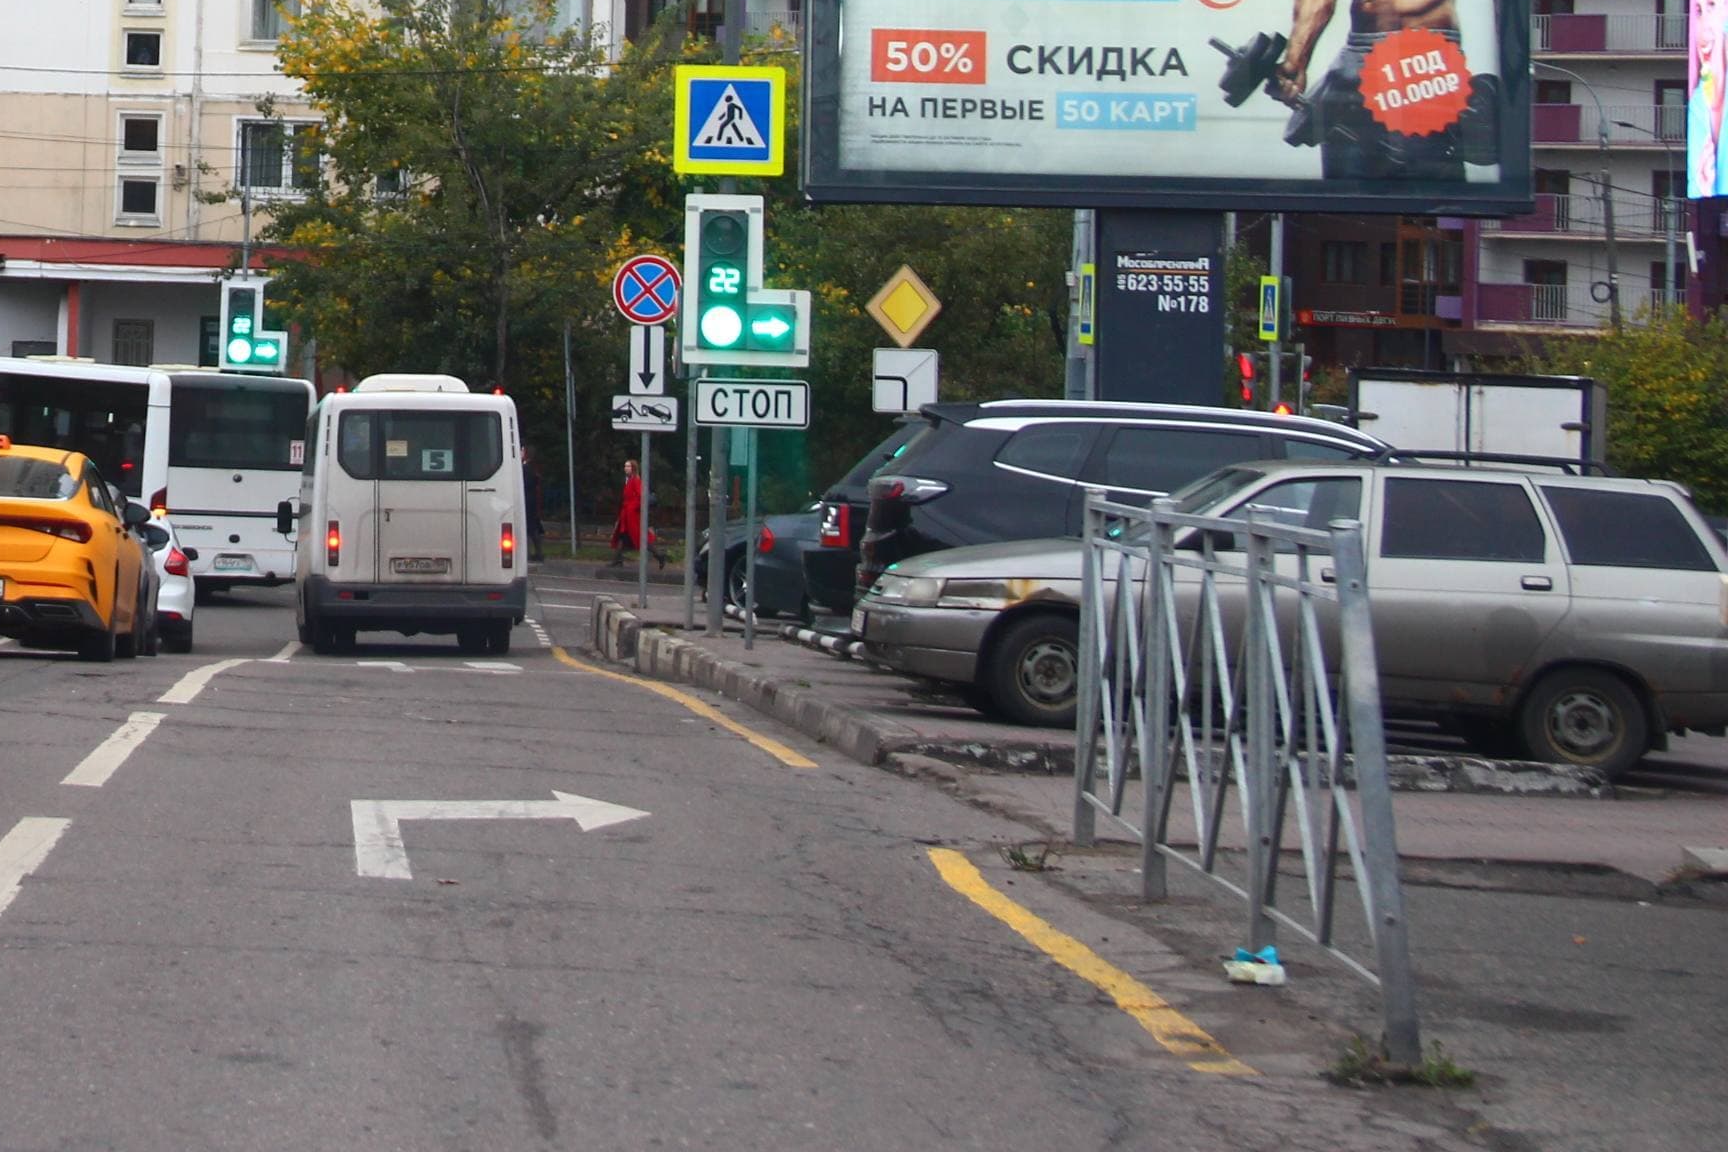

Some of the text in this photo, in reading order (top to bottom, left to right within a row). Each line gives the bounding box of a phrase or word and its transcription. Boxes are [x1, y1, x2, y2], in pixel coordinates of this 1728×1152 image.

[885, 41, 973, 73] 50%
[1007, 45, 1189, 81] СКИДКА
[1381, 50, 1447, 83] 1 ГОД
[869, 96, 909, 117] НА
[921, 99, 1045, 121] ПЕРВЫЕ
[1063, 100, 1100, 122] 50
[709, 267, 740, 294] 22
[711, 388, 792, 419] СТОП
[429, 452, 446, 470] 5
